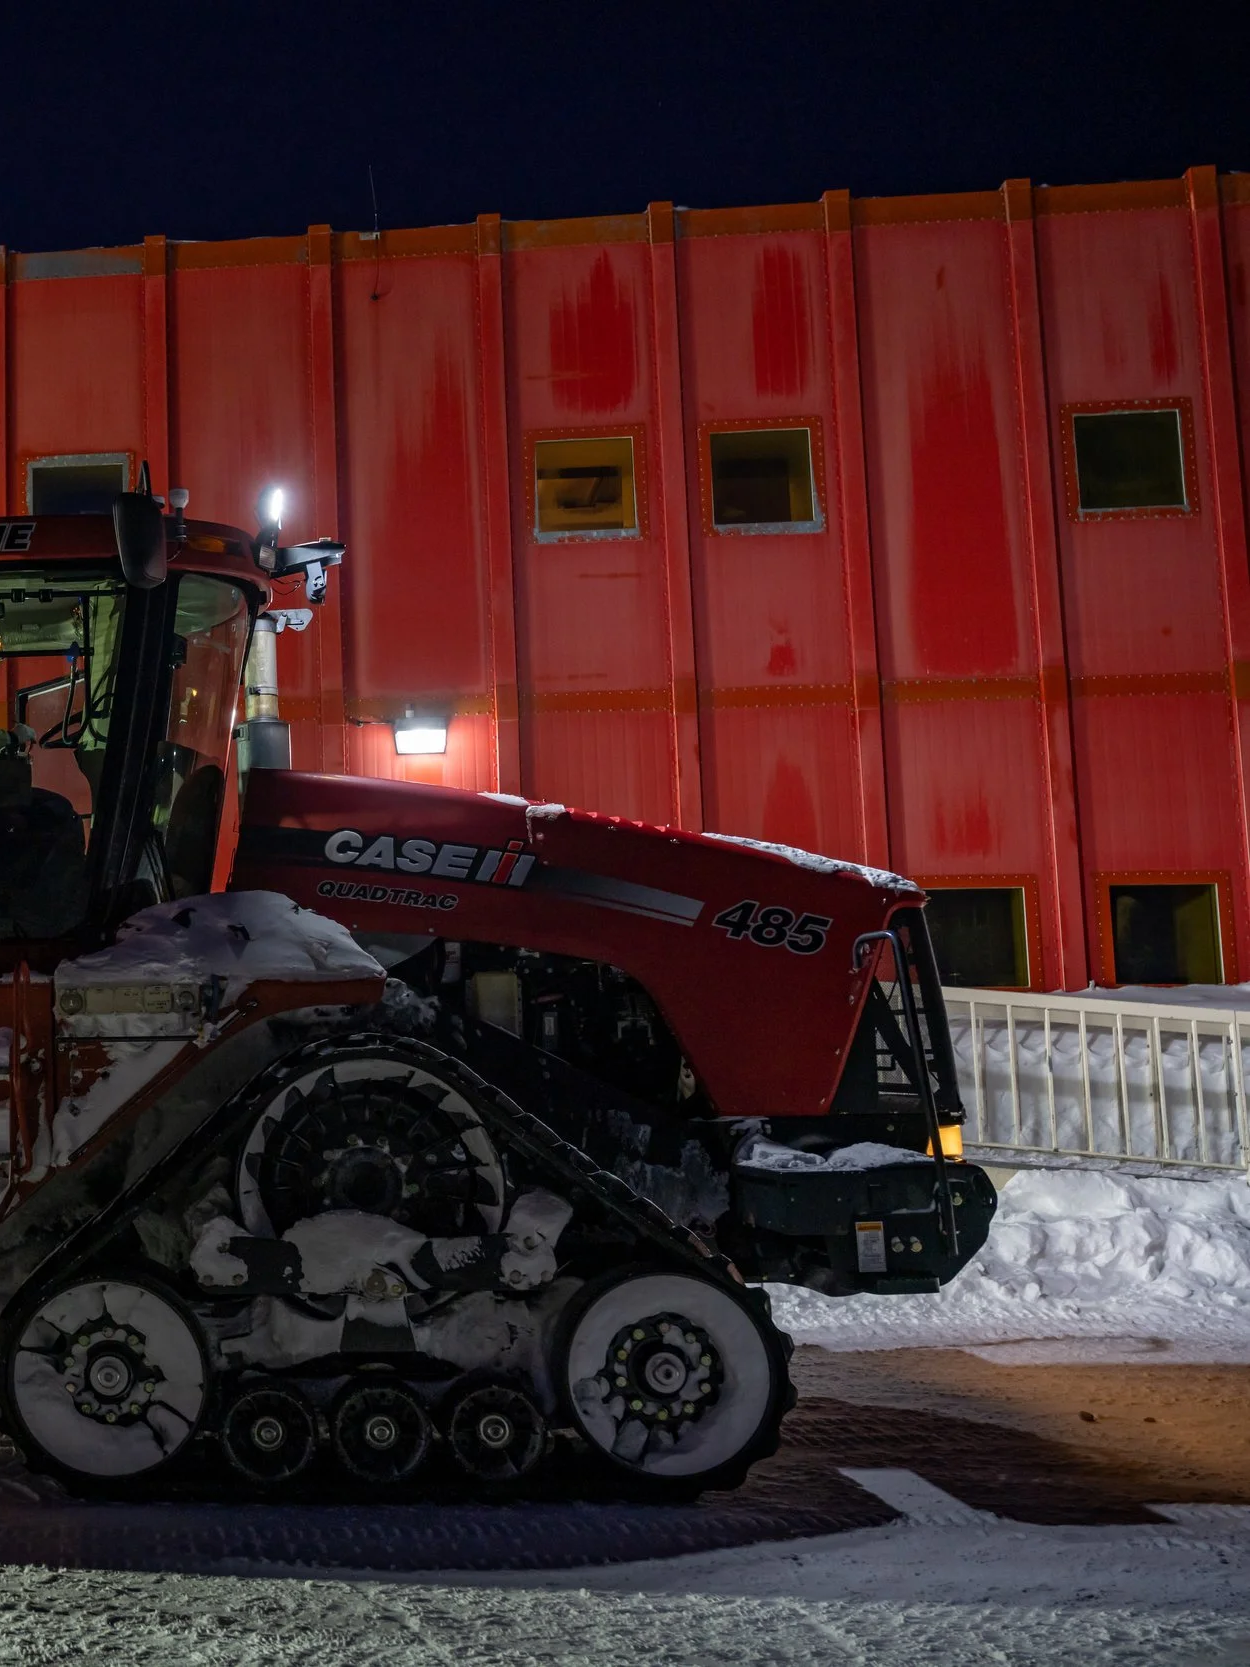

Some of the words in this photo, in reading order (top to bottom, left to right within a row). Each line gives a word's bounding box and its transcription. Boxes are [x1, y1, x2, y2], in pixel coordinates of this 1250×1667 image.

[324, 830, 478, 880] CASE
[317, 880, 459, 910] QUADTRAC
[711, 899, 835, 955] 485
